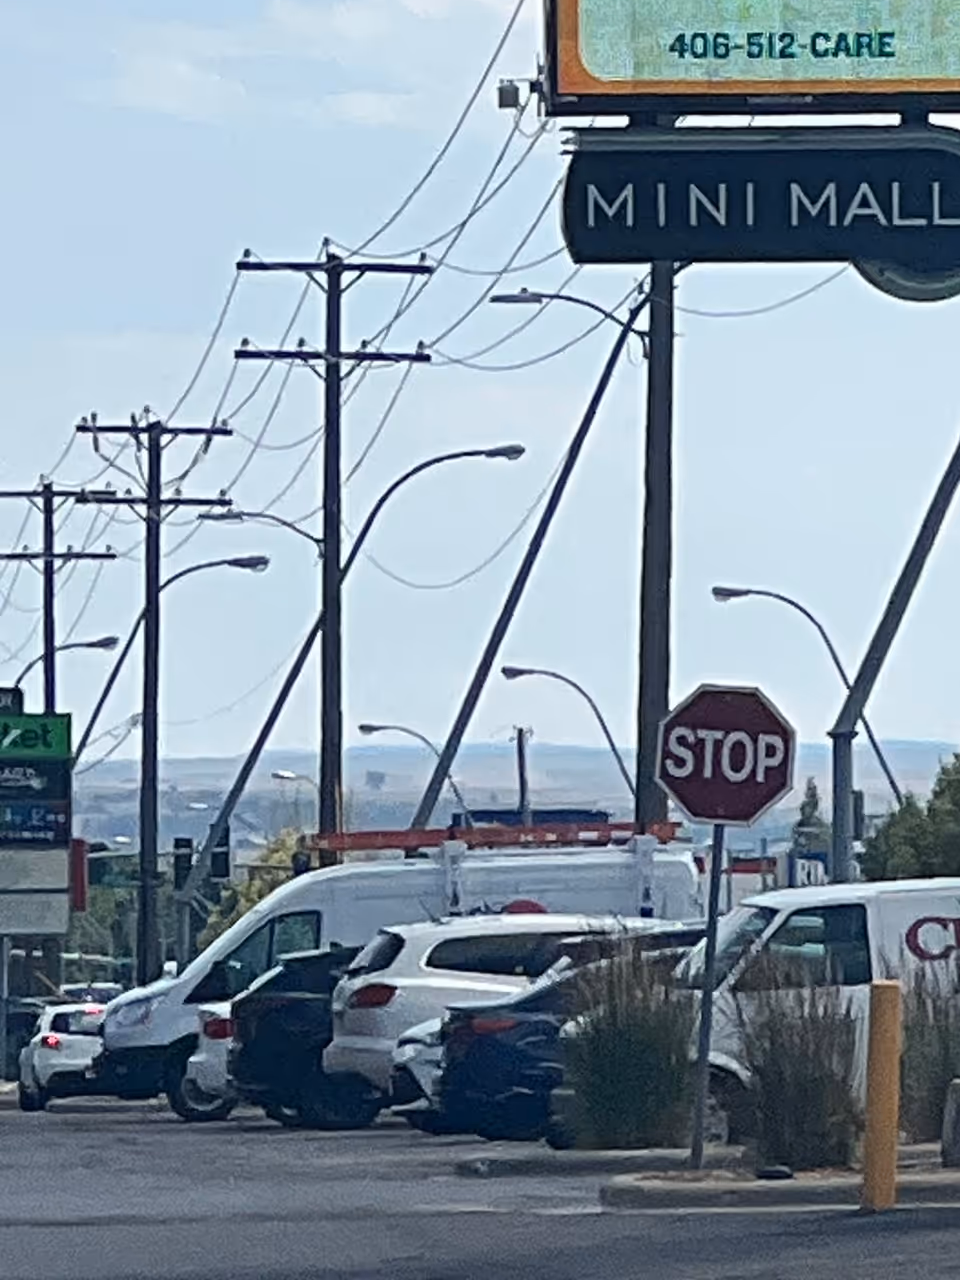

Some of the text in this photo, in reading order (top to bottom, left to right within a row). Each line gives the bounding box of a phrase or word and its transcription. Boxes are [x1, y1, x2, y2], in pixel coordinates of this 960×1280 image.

[669, 32, 896, 59] 406-512-CARE
[586, 182, 755, 227] MINI
[664, 727, 785, 783] STOP
